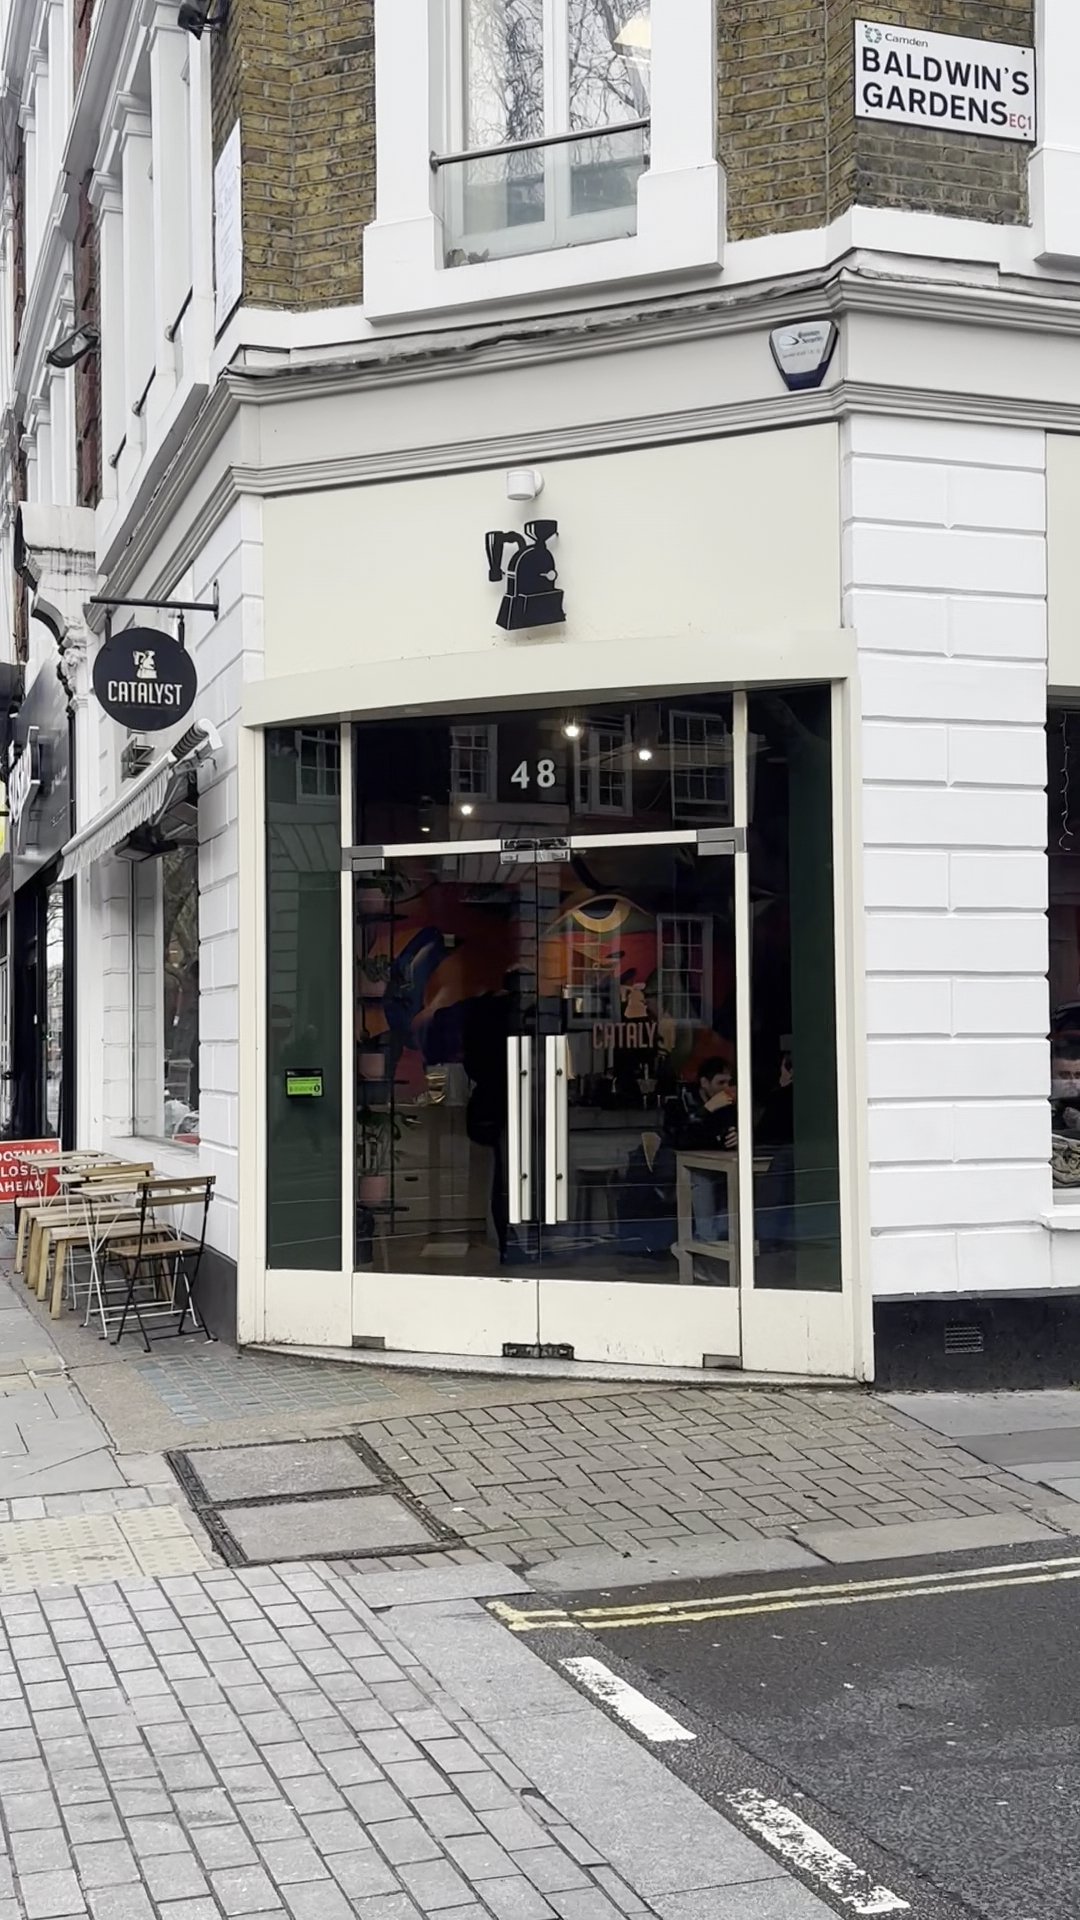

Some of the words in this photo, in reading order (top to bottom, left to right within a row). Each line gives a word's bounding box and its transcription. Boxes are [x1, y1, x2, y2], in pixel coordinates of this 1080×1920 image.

[884, 33, 929, 48] Camden
[862, 46, 1030, 96] BALDWIN'S
[862, 82, 1008, 126] GARDENS
[1009, 114, 1032, 130] EC1
[108, 680, 183, 706] CATALYST
[510, 759, 556, 789] 48
[0, 1165, 47, 1178] LOSED
